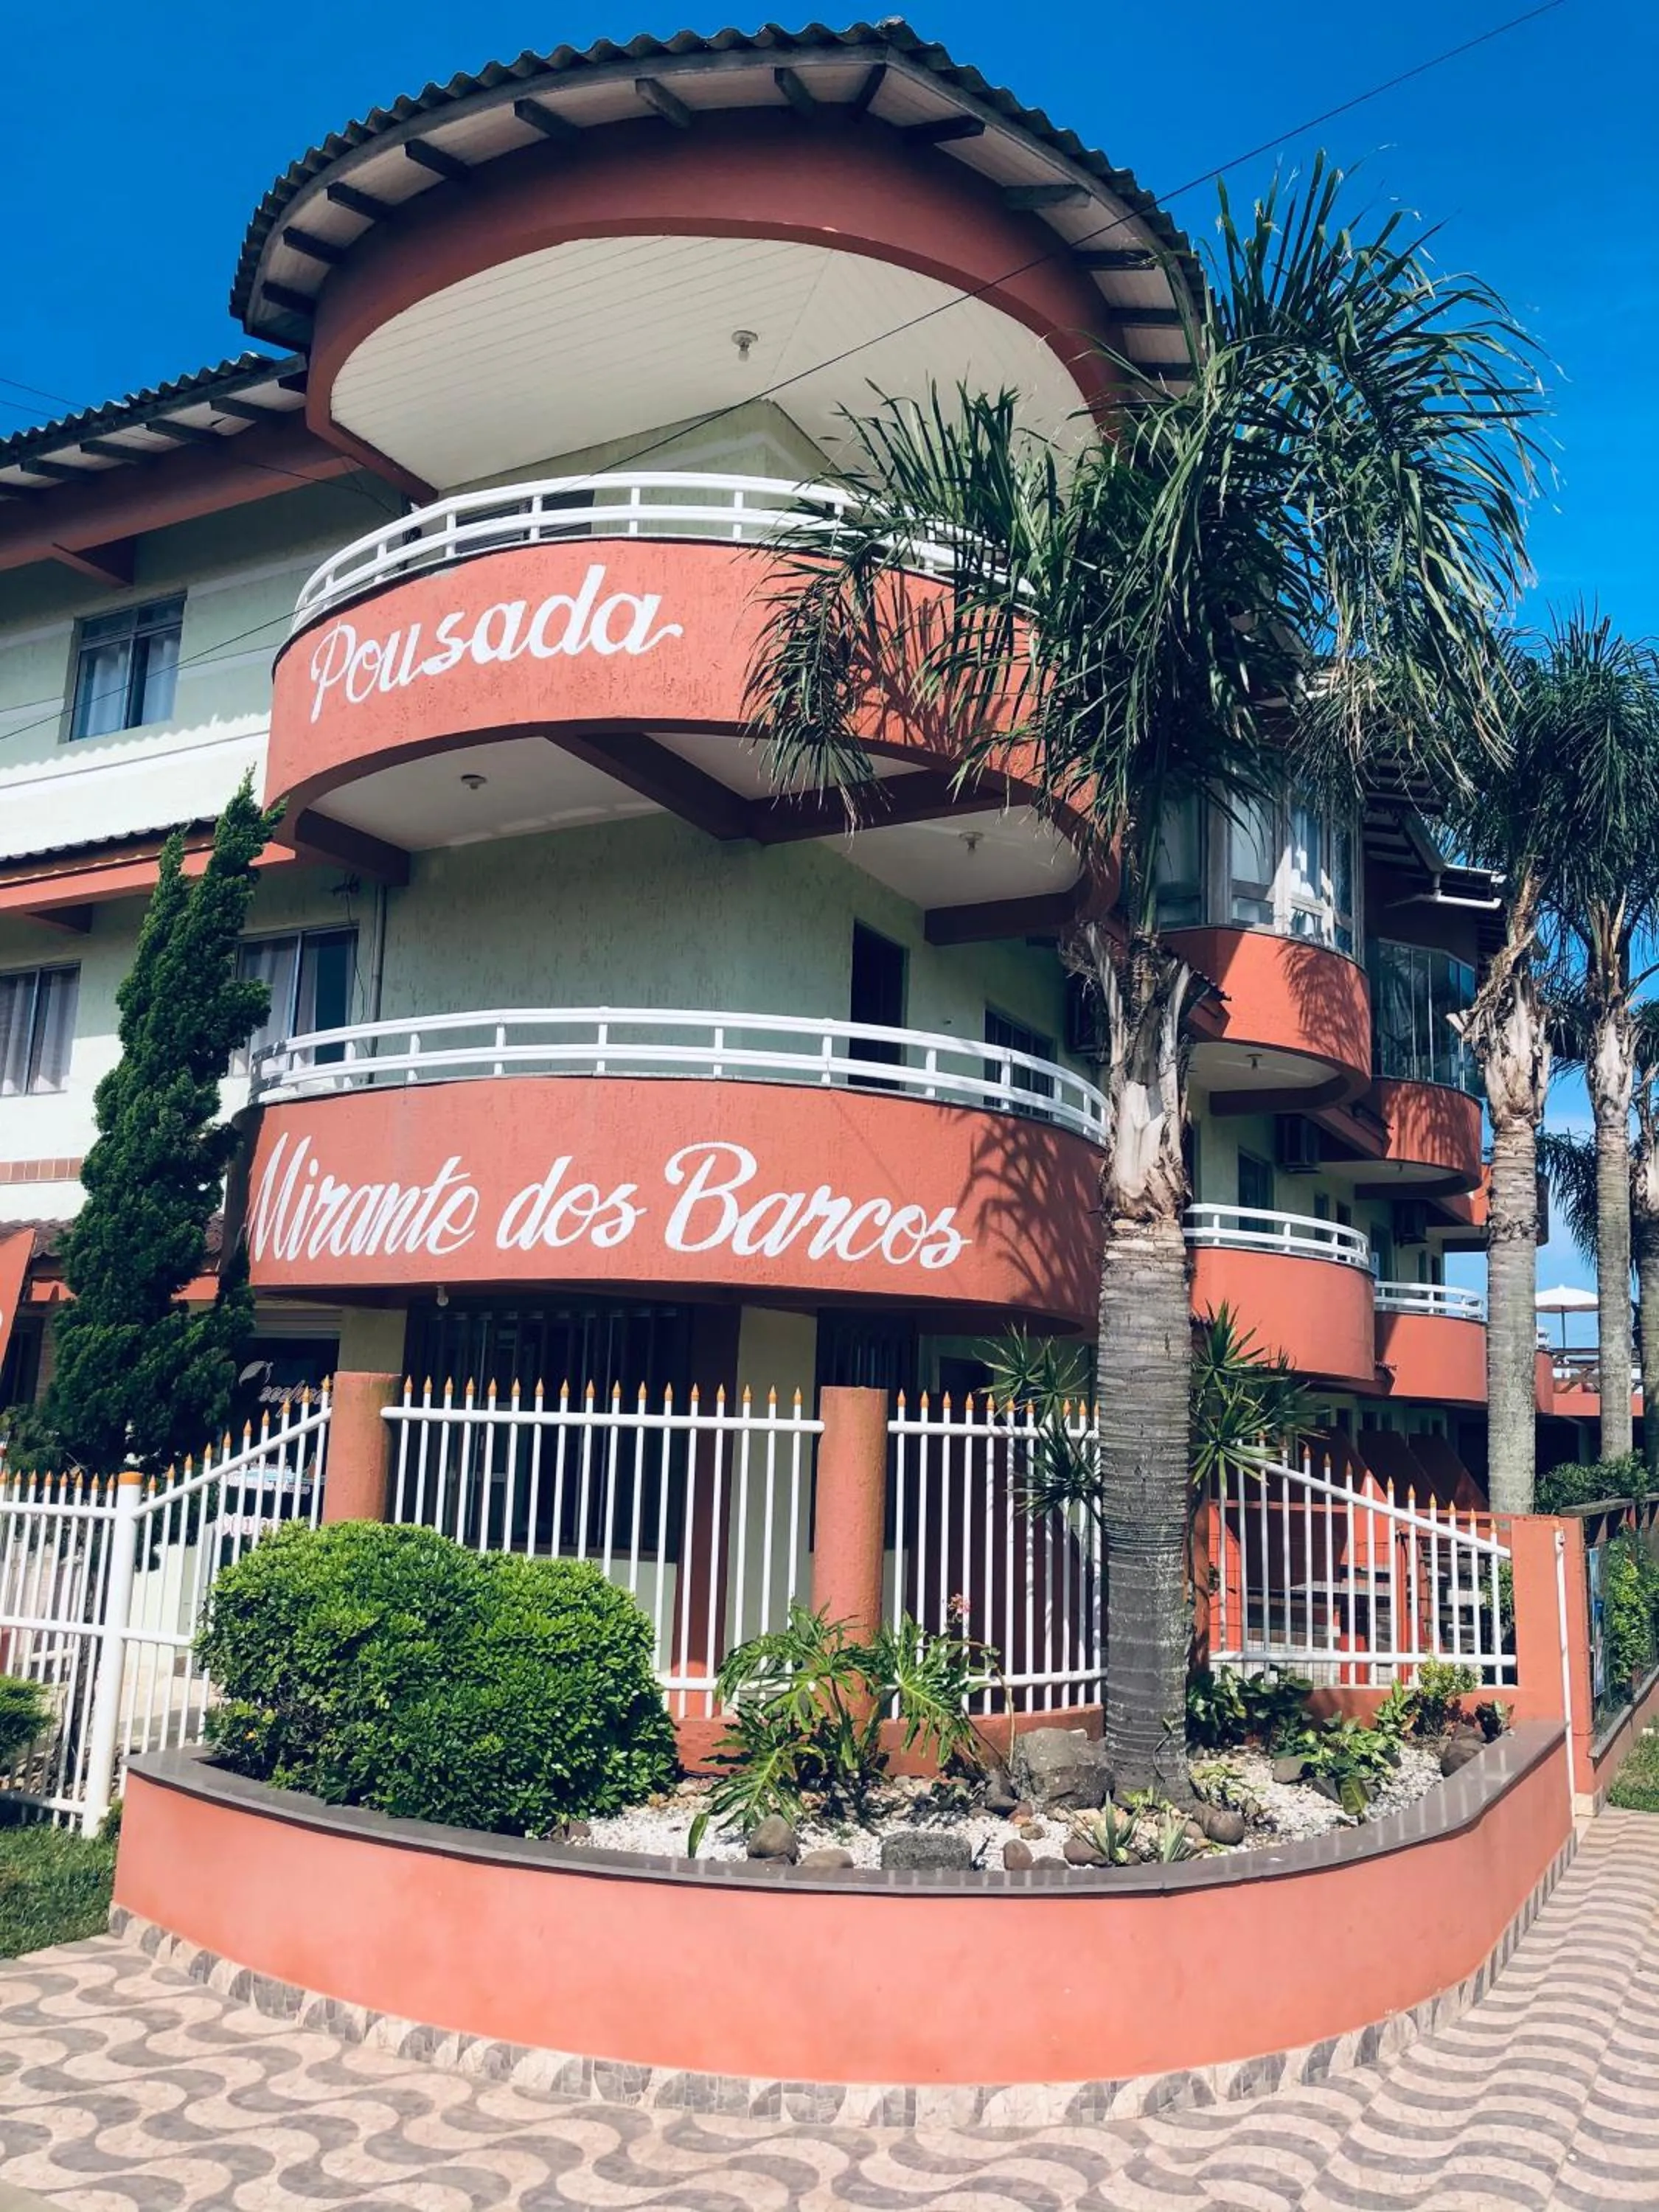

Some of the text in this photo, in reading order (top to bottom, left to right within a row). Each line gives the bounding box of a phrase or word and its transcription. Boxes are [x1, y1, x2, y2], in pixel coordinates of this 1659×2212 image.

[310, 563, 684, 723] Pousada
[246, 1132, 973, 1270] Mirante dos Barcos
